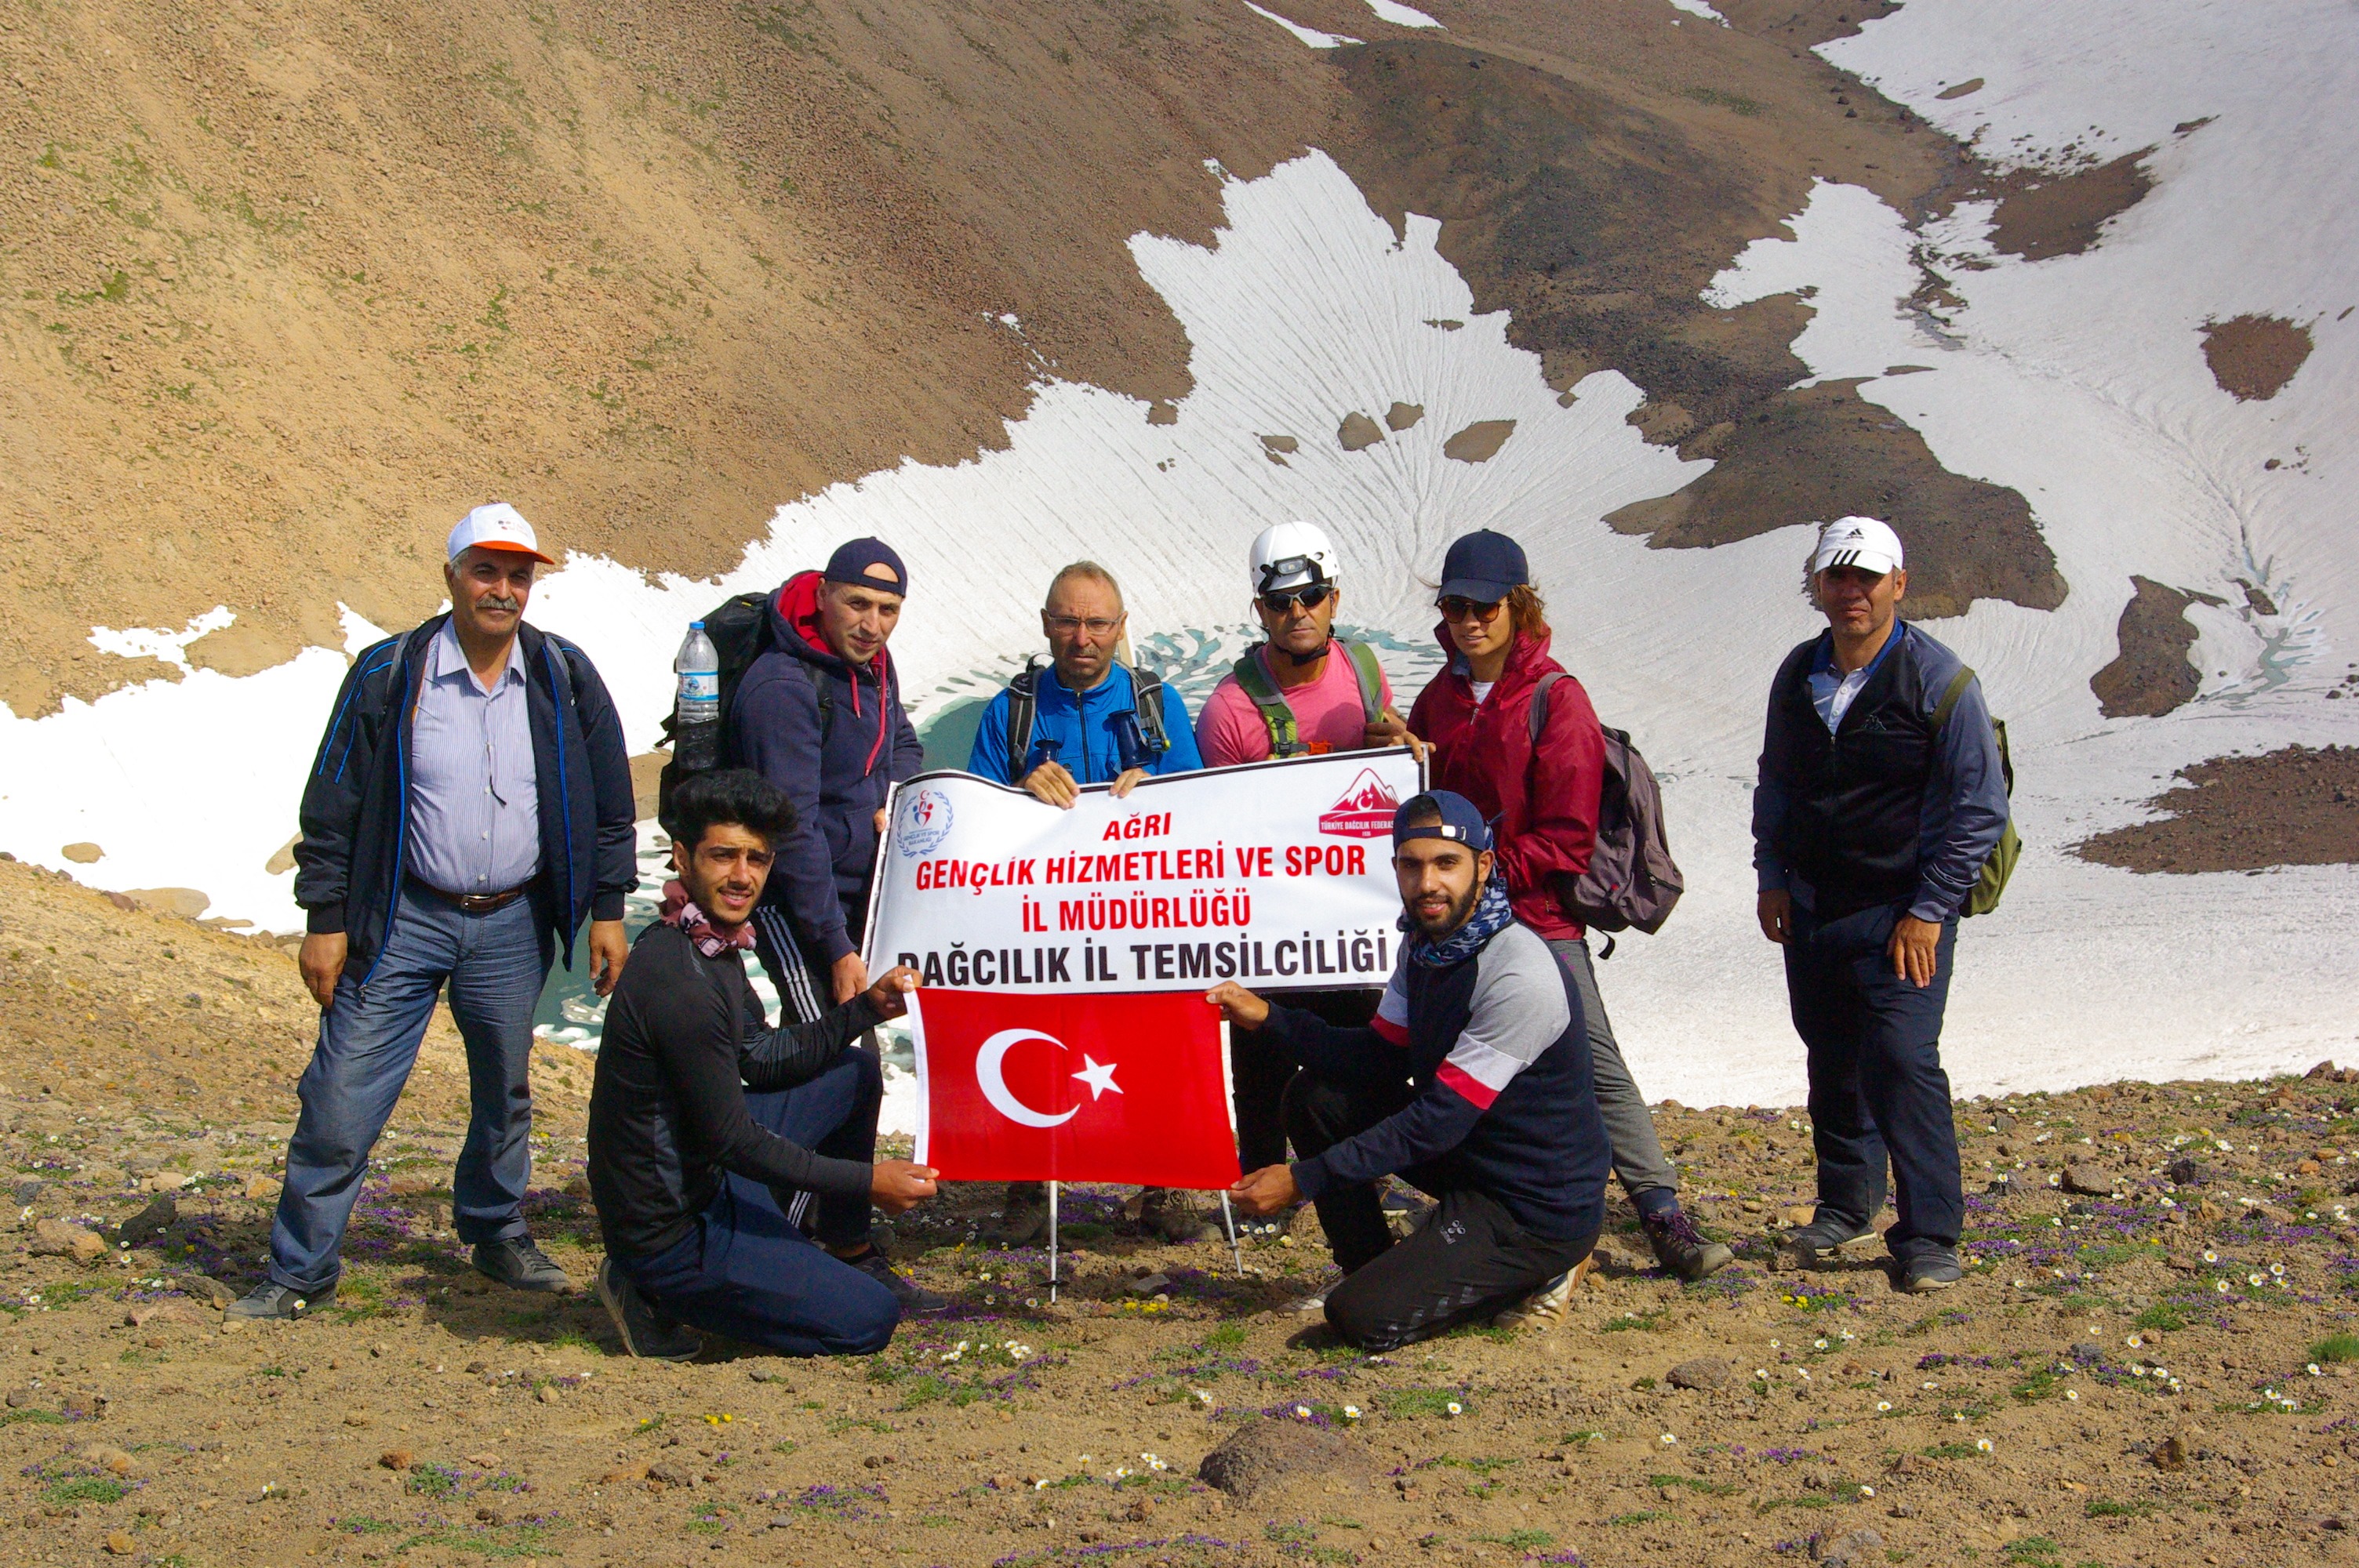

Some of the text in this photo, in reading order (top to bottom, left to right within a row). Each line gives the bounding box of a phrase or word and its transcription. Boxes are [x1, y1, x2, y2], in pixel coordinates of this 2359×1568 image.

[1102, 811, 1172, 841] AĞRI
[1321, 820, 1344, 830] TÜRKİYE
[916, 840, 1366, 896] GENÇLİK HİZMETLERİ VE SPOR
[1022, 887, 1251, 933] İL MÜDÜRLÜĞÜ
[897, 928, 1387, 987] DAĞCILIK İL TEMSİLCİLİĞİ
